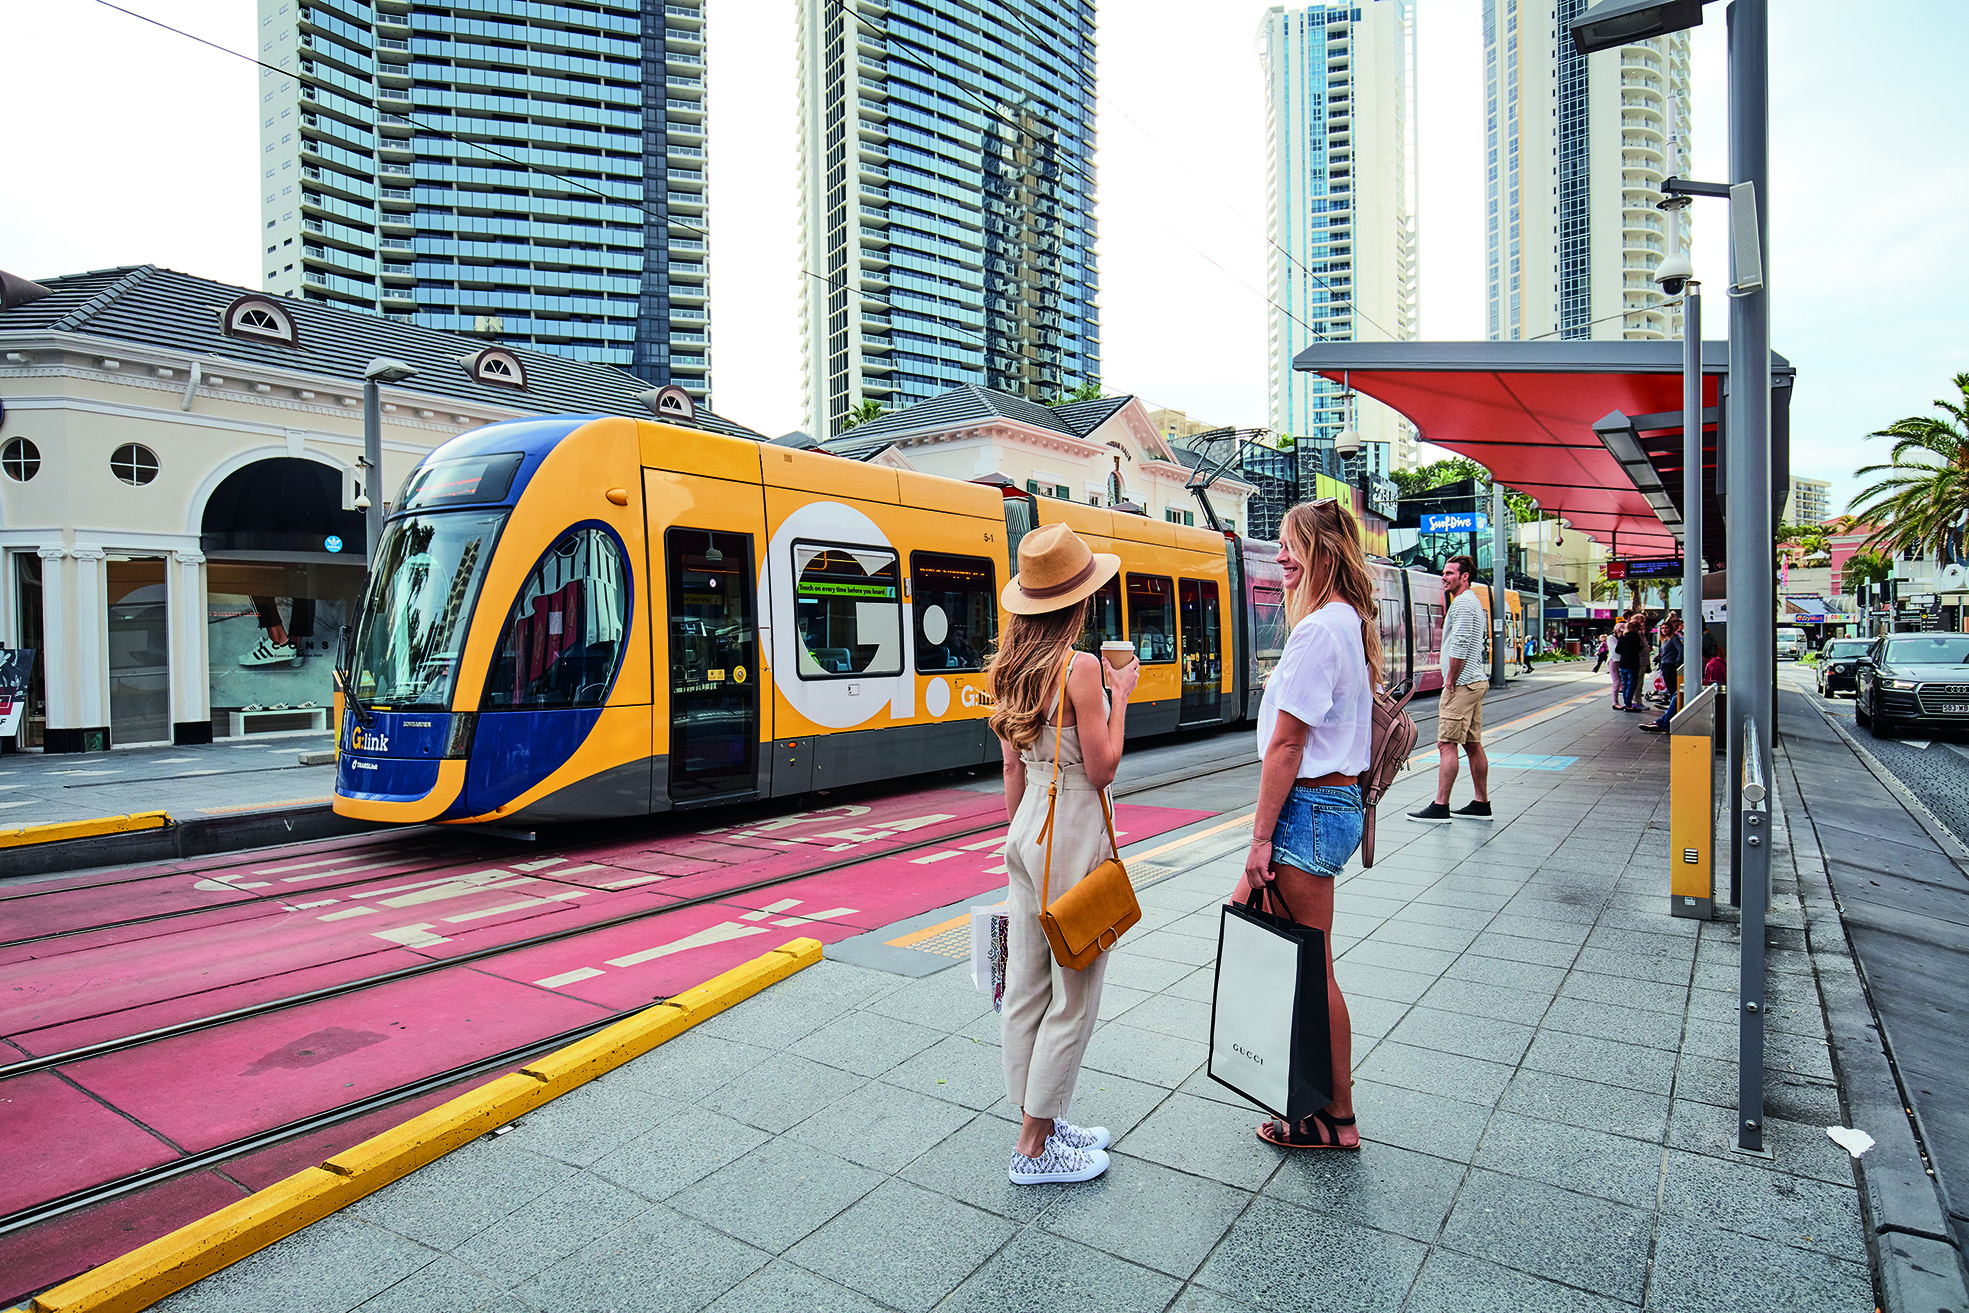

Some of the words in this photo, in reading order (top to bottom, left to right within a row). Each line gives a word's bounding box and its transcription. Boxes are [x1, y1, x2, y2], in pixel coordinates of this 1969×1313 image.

[983, 532, 994, 543] 5-1
[799, 584, 813, 592] Touch
[847, 586, 862, 594] before
[352, 726, 389, 752] G:link
[1232, 1043, 1264, 1066] GUCCI
